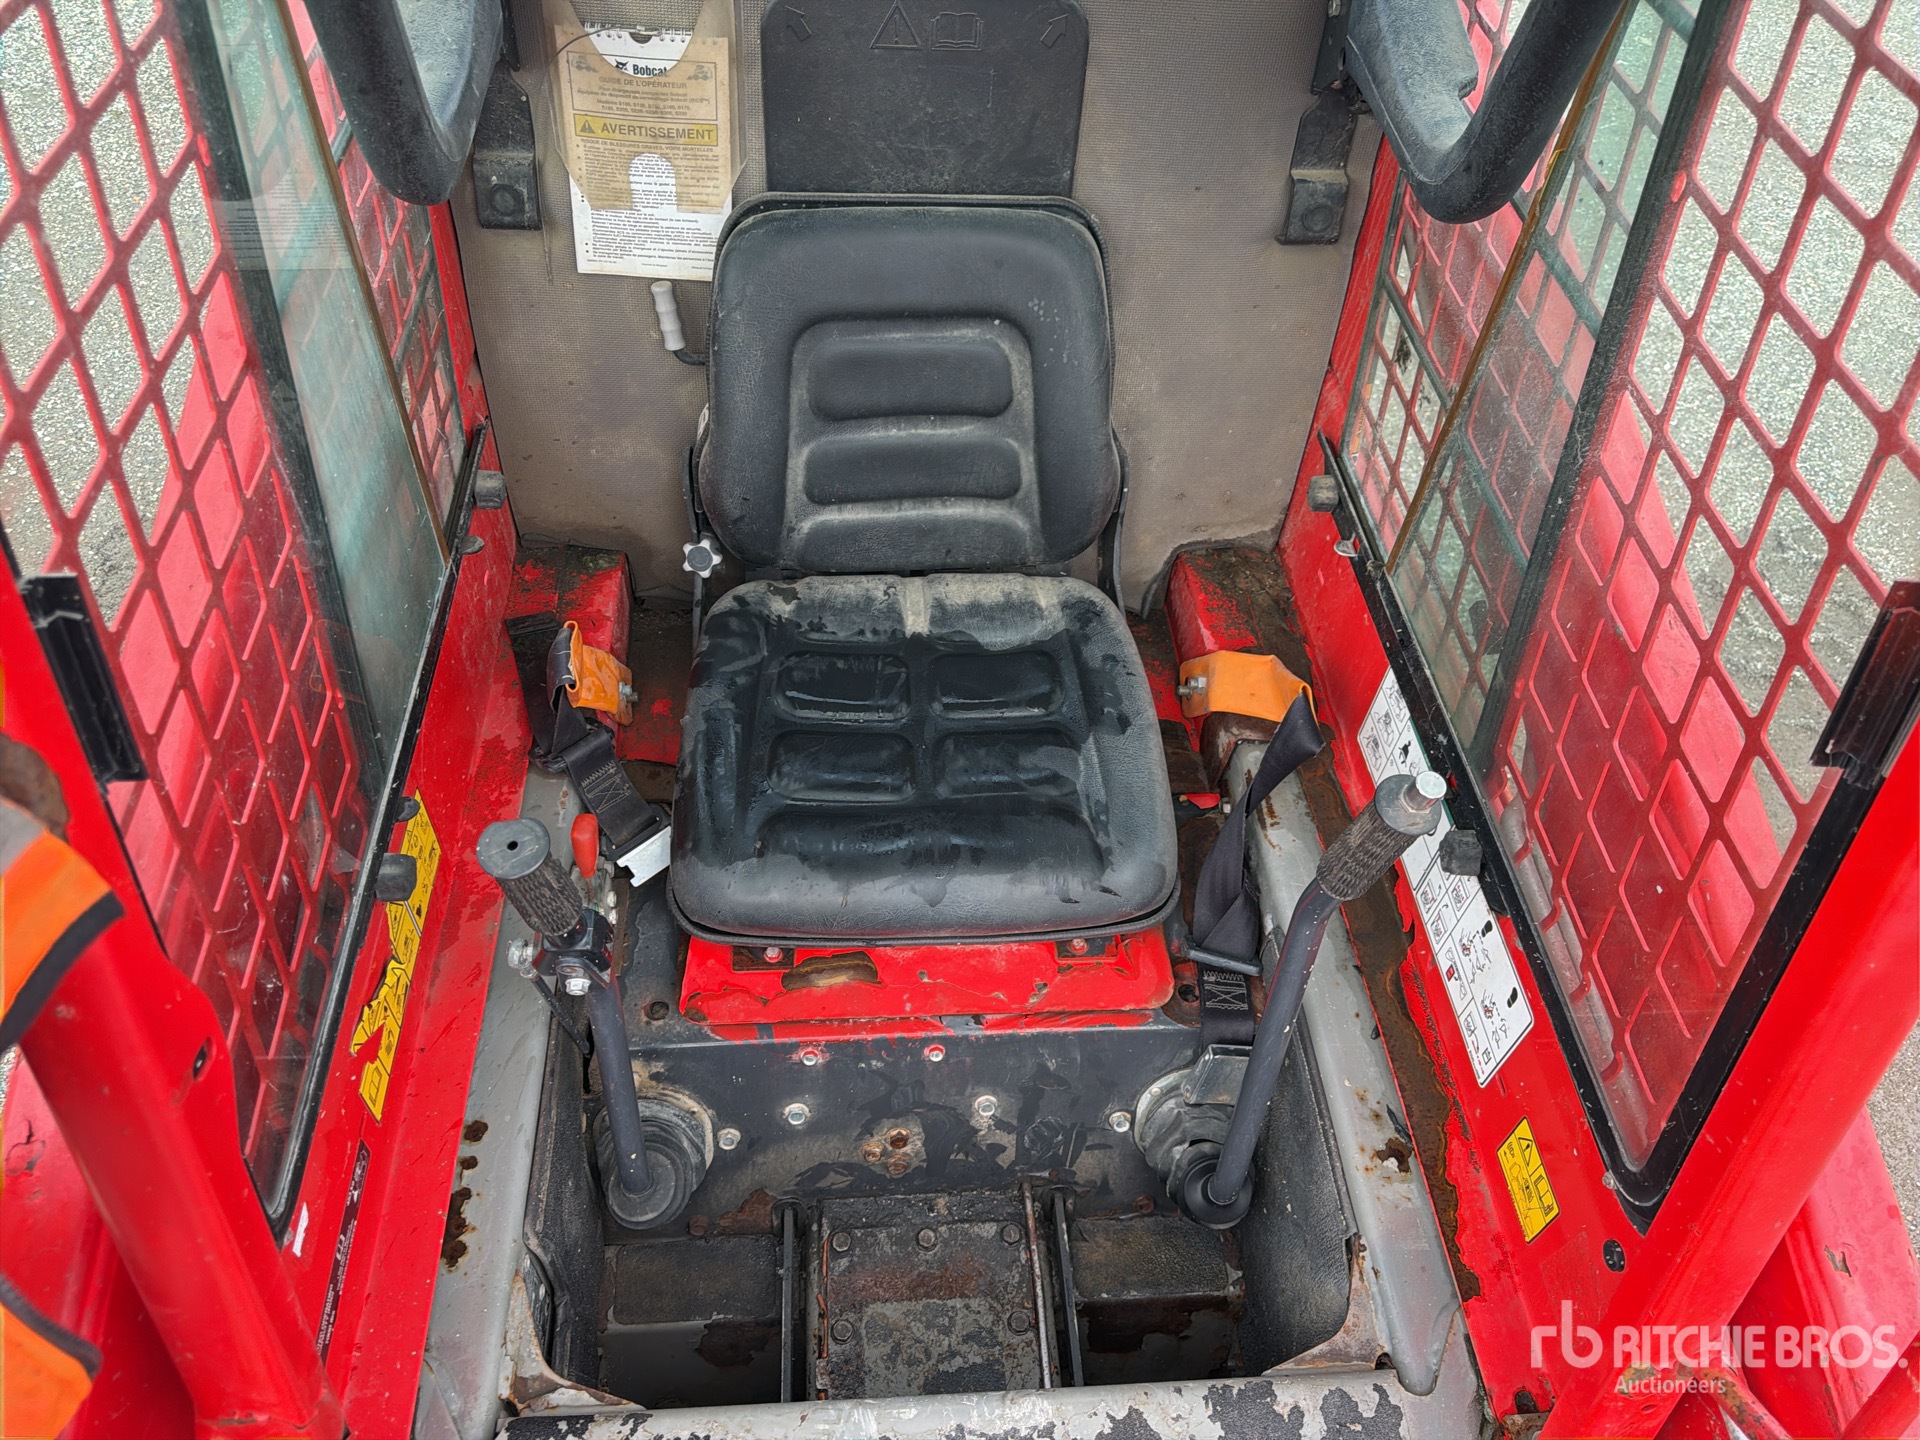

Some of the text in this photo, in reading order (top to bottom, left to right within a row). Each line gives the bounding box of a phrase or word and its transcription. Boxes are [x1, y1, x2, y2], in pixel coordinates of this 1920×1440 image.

[632, 64, 668, 76] Bobcat
[599, 76, 622, 85] GUIDE
[600, 122, 714, 140] AVERTISSEMENT
